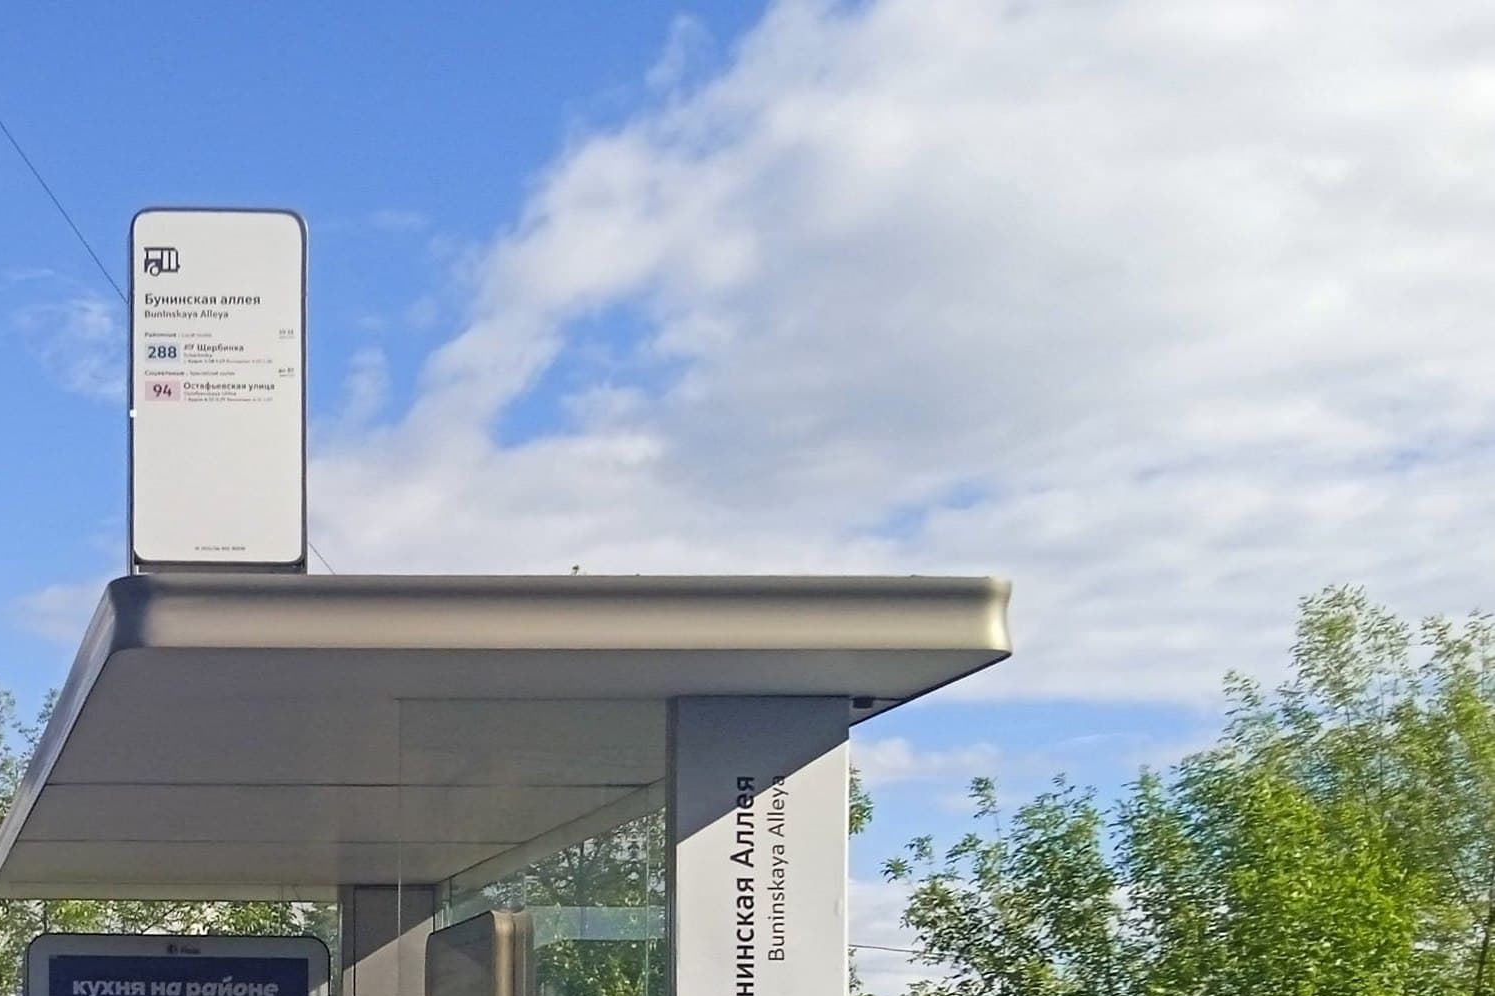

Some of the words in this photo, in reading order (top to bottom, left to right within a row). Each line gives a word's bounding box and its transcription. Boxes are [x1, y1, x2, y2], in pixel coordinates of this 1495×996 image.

[145, 293, 216, 307] Бунинская
[220, 295, 261, 305] аллея
[144, 309, 198, 320] Buninskaya
[200, 309, 229, 320] Alleya
[147, 345, 178, 360] 288
[197, 343, 245, 353] Щербинка
[152, 383, 172, 398] 94
[248, 383, 275, 391] улица
[766, 775, 789, 838] Alleya
[729, 775, 755, 868] Аллея
[766, 843, 789, 962] Buninskaya
